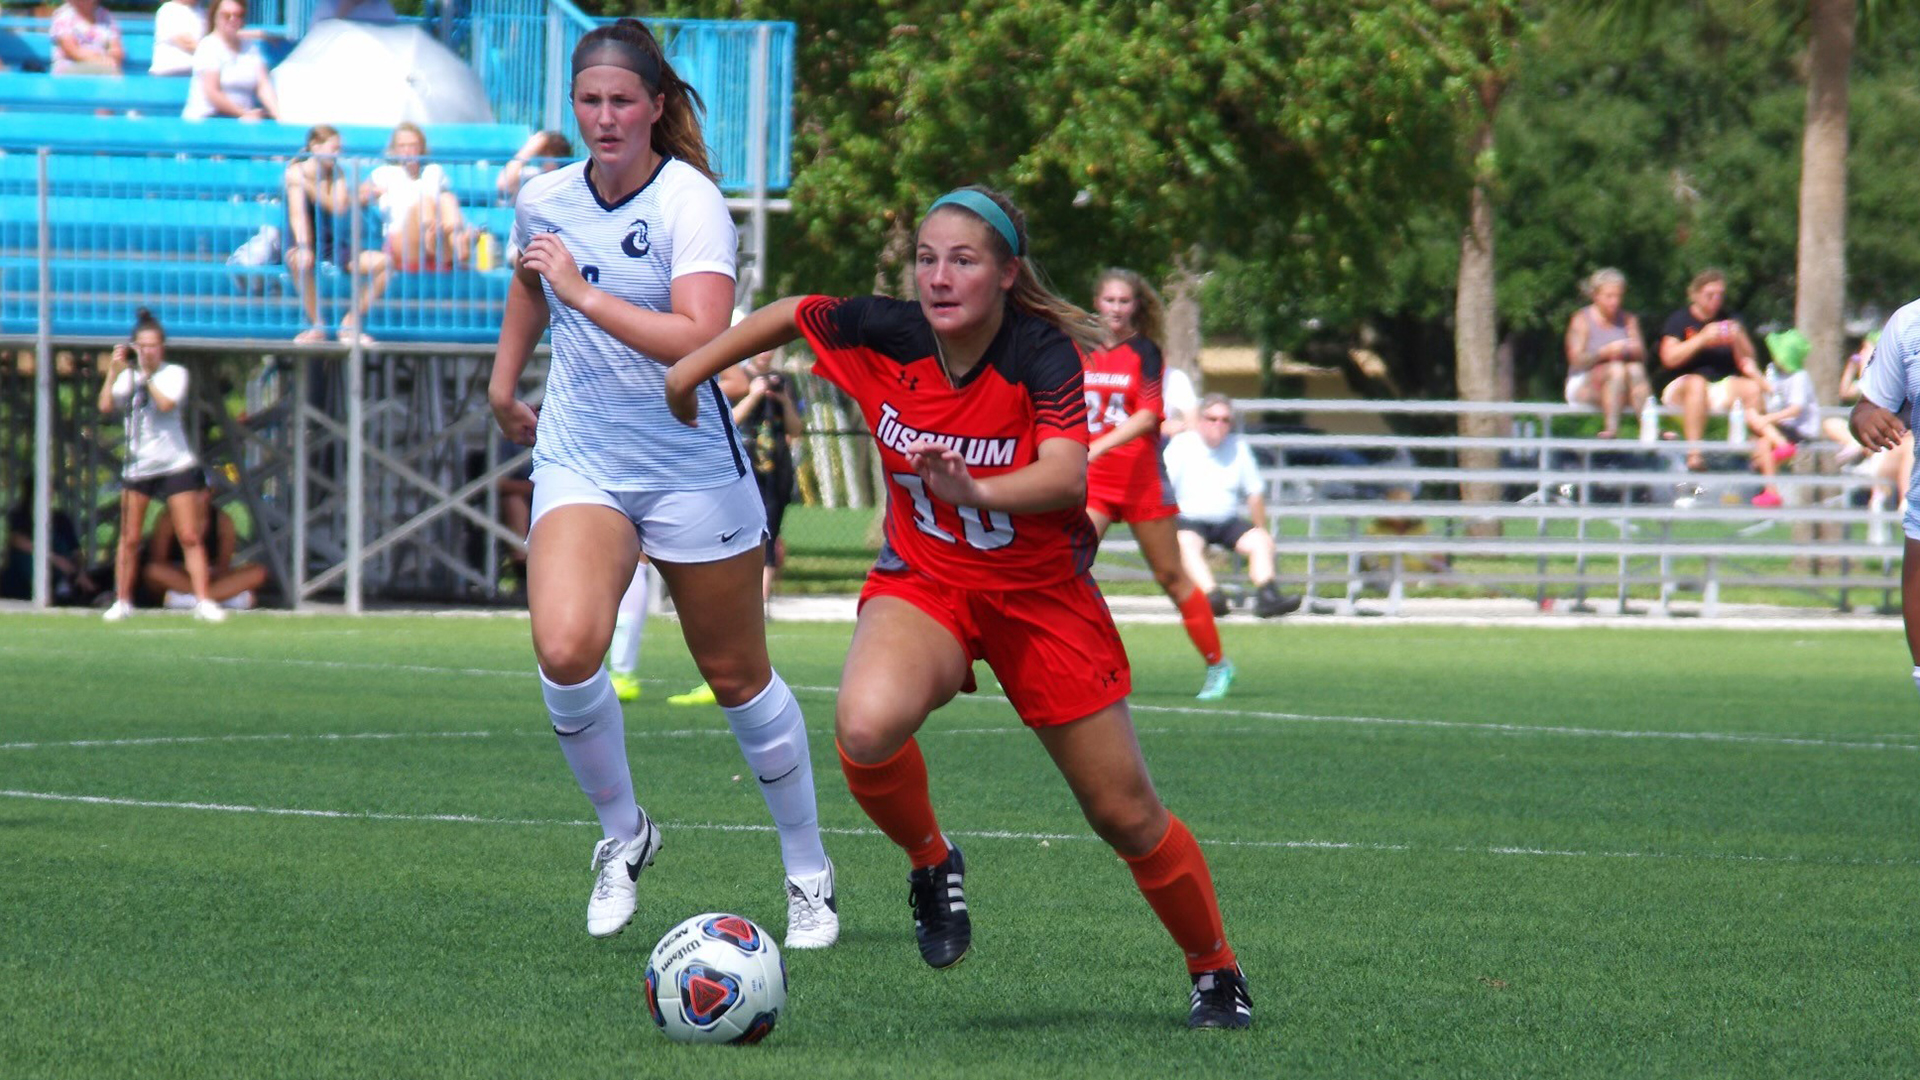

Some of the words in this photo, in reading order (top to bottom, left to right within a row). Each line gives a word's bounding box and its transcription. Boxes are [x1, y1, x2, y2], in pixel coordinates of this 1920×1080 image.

[1084, 391, 1131, 433] 24
[891, 472, 1015, 550] 10
[660, 939, 702, 973] Wilson
